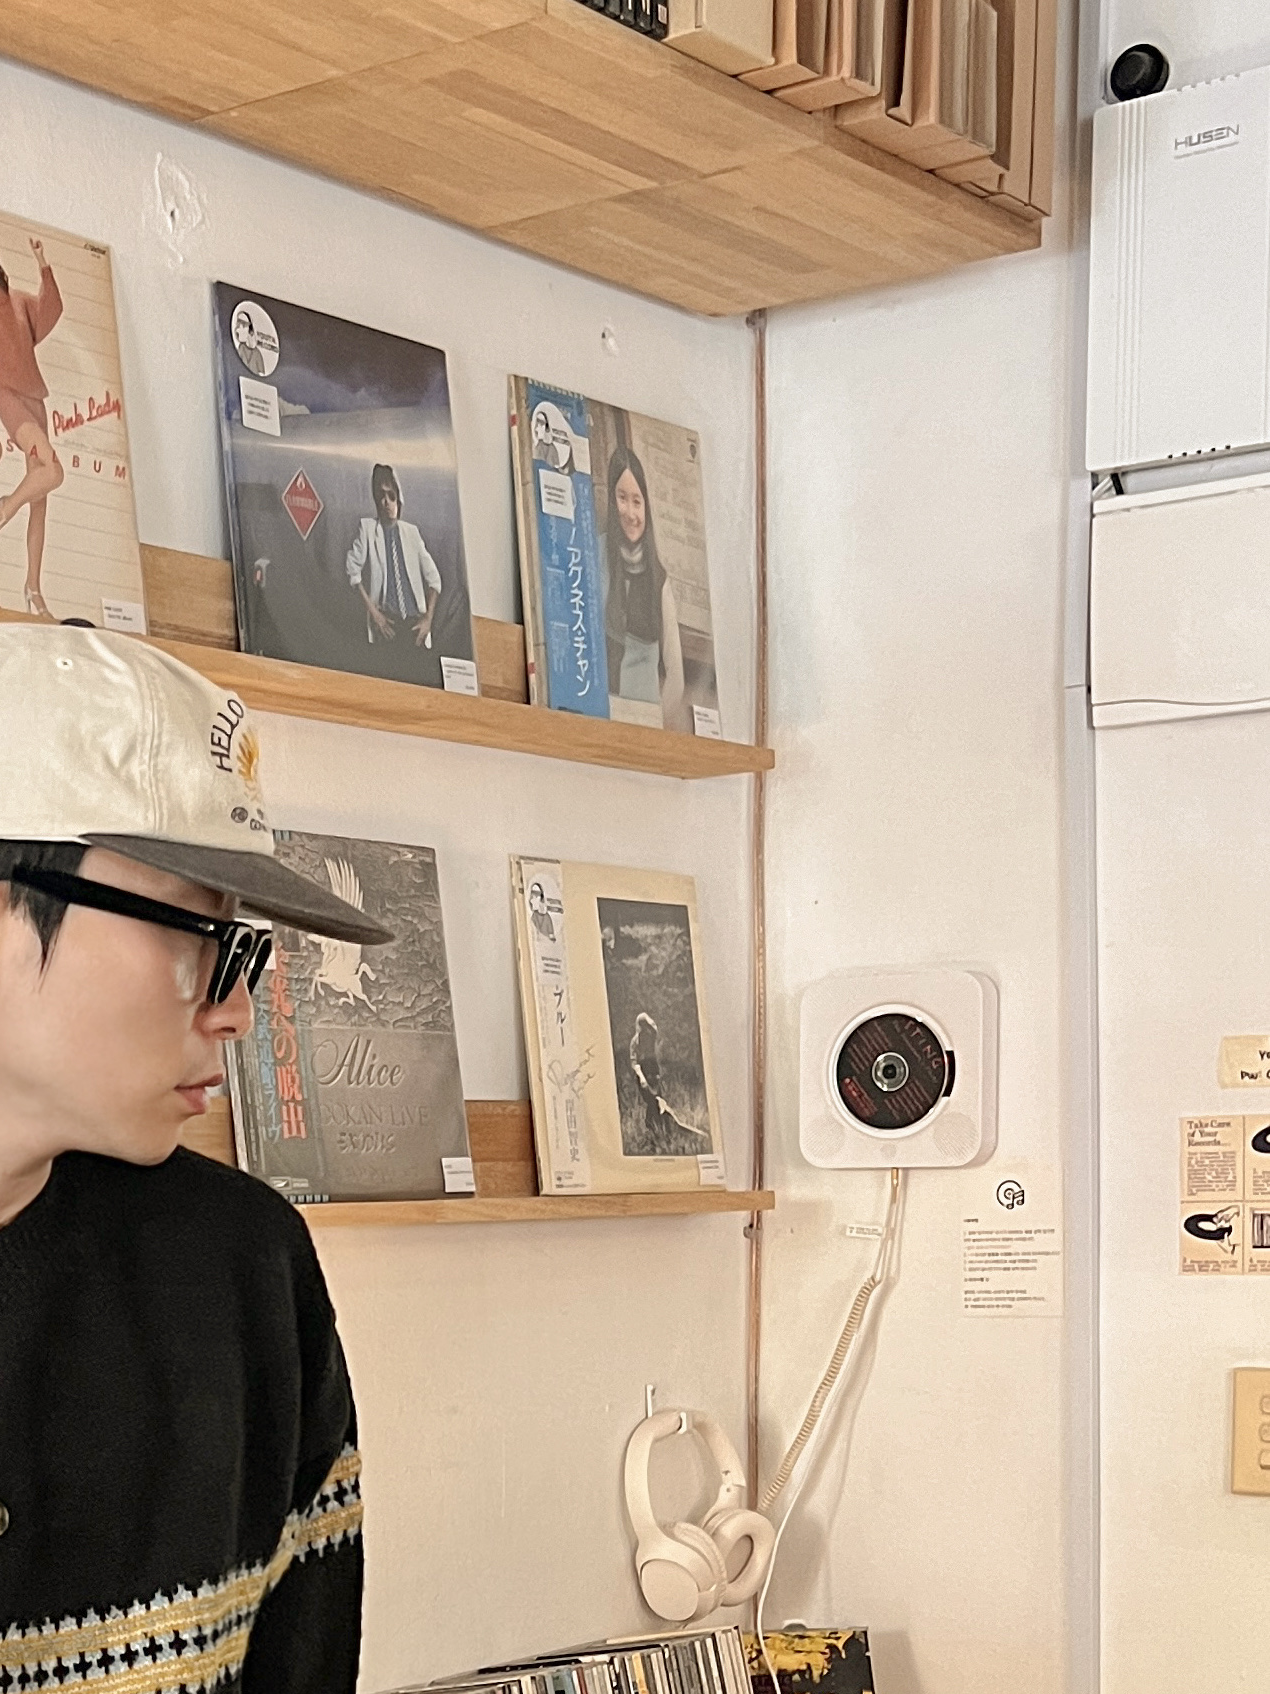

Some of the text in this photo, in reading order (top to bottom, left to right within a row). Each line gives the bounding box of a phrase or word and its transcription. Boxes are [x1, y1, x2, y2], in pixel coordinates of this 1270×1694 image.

[1173, 123, 1240, 151] HUSEN
[52, 391, 123, 437] Pink Lady
[29, 443, 127, 480] ALBUM
[210, 698, 245, 773] HELLO
[310, 1032, 406, 1087] Alice
[390, 1105, 430, 1127] LIVE
[1199, 1129, 1219, 1138] Your
